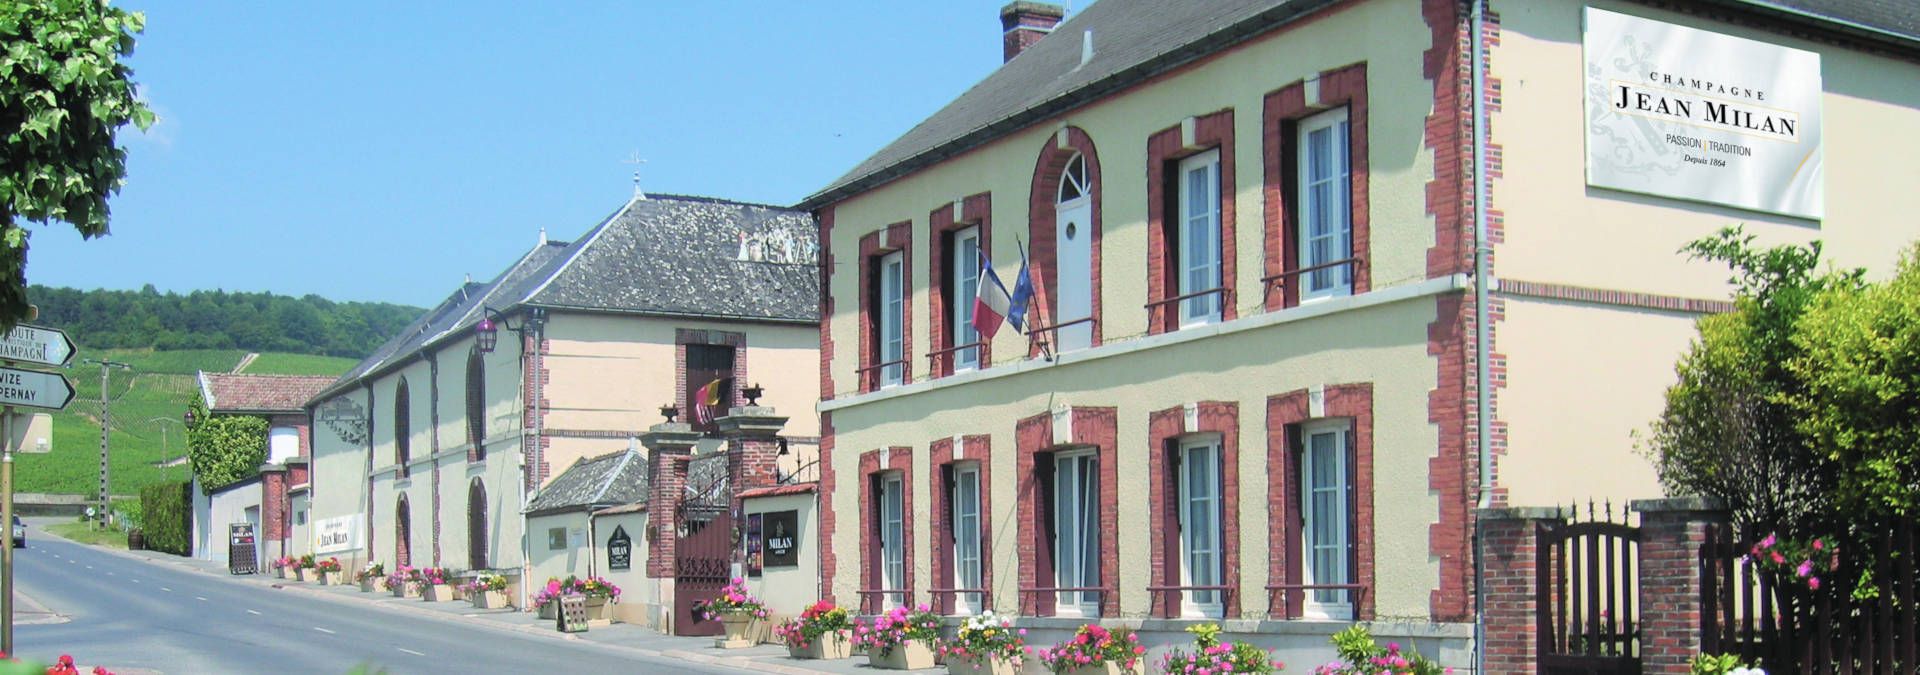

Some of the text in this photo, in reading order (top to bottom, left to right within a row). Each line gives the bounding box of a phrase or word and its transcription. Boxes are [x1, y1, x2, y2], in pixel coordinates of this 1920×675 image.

[1650, 71, 1765, 101] CHAMPAGNE
[1615, 85, 1796, 137] JEAN MILAN
[1666, 133, 1751, 157] PASSION TRADITION
[1683, 154, 1726, 168] Depuis 1864
[10, 327, 35, 340] OUTE
[768, 536, 793, 550] MILAN
